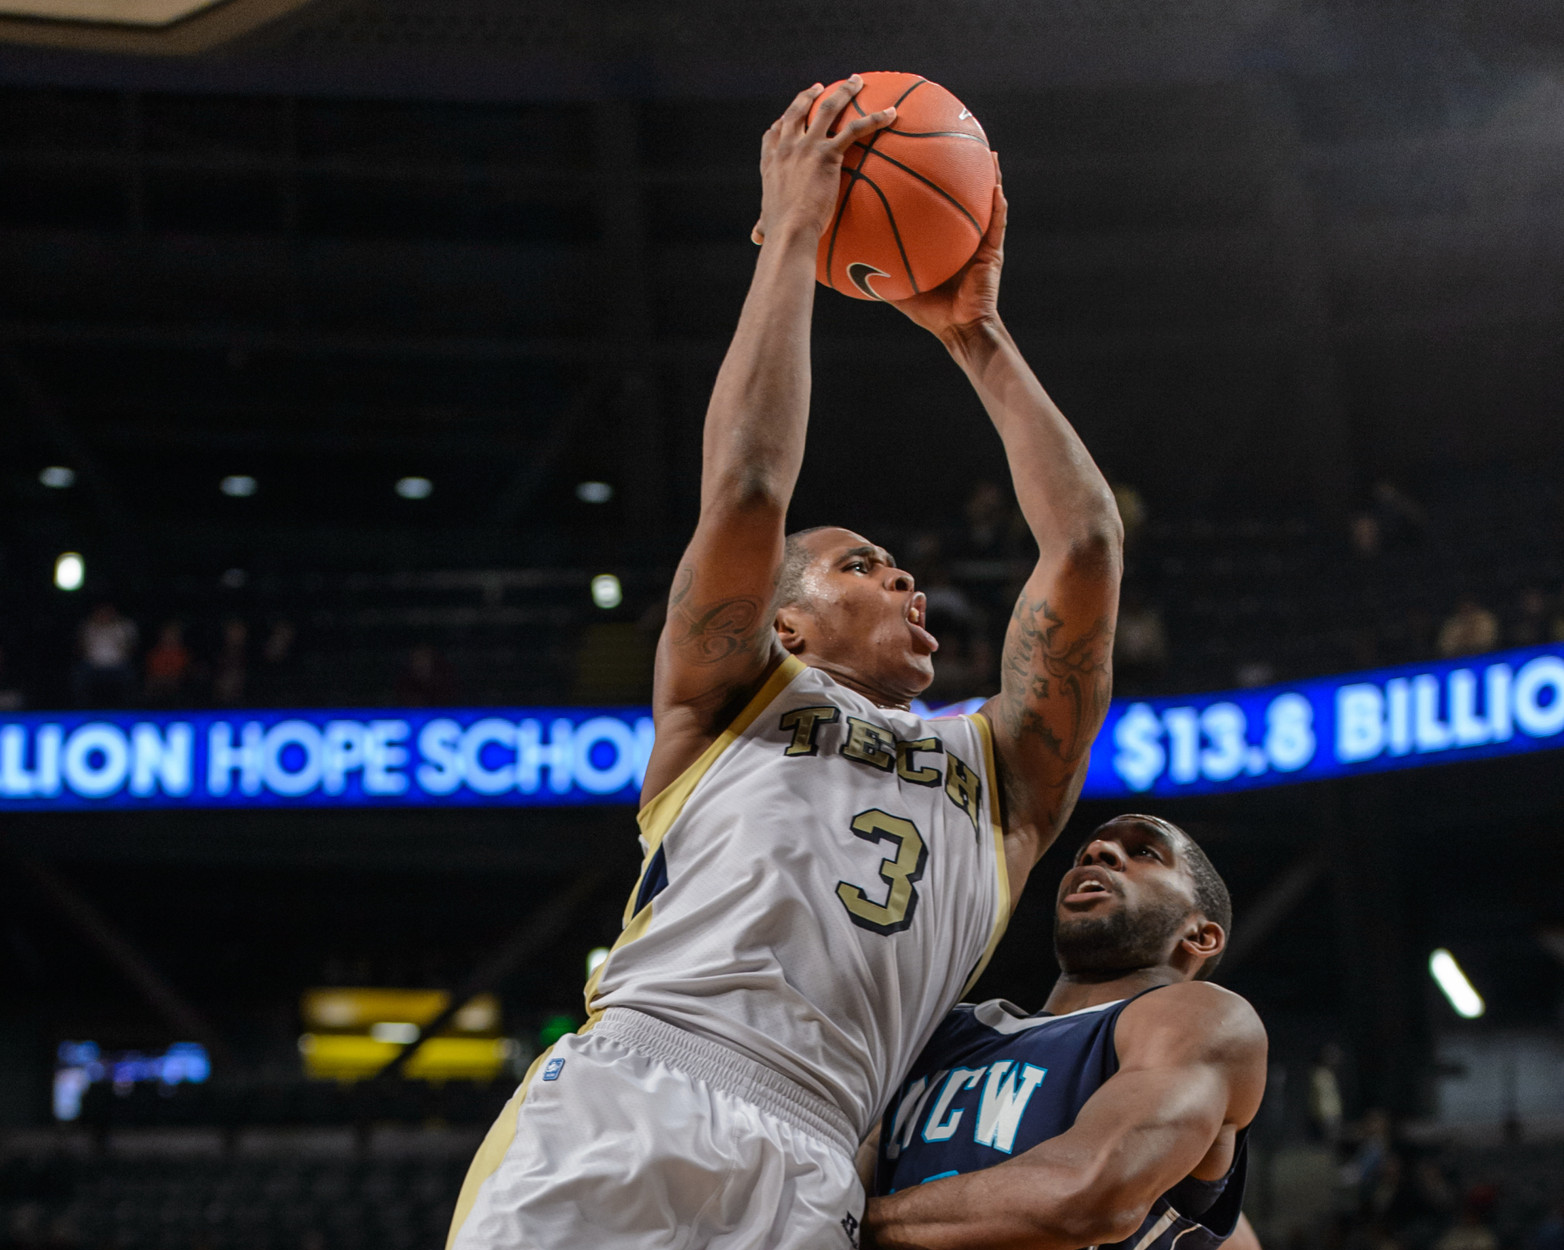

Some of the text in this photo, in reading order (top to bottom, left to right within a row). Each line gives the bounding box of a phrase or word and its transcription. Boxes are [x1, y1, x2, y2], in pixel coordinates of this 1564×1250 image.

[208, 719, 410, 797] HOPE
[779, 706, 982, 844] TECH
[1112, 701, 1317, 792] $13.8
[835, 808, 929, 937] 3
